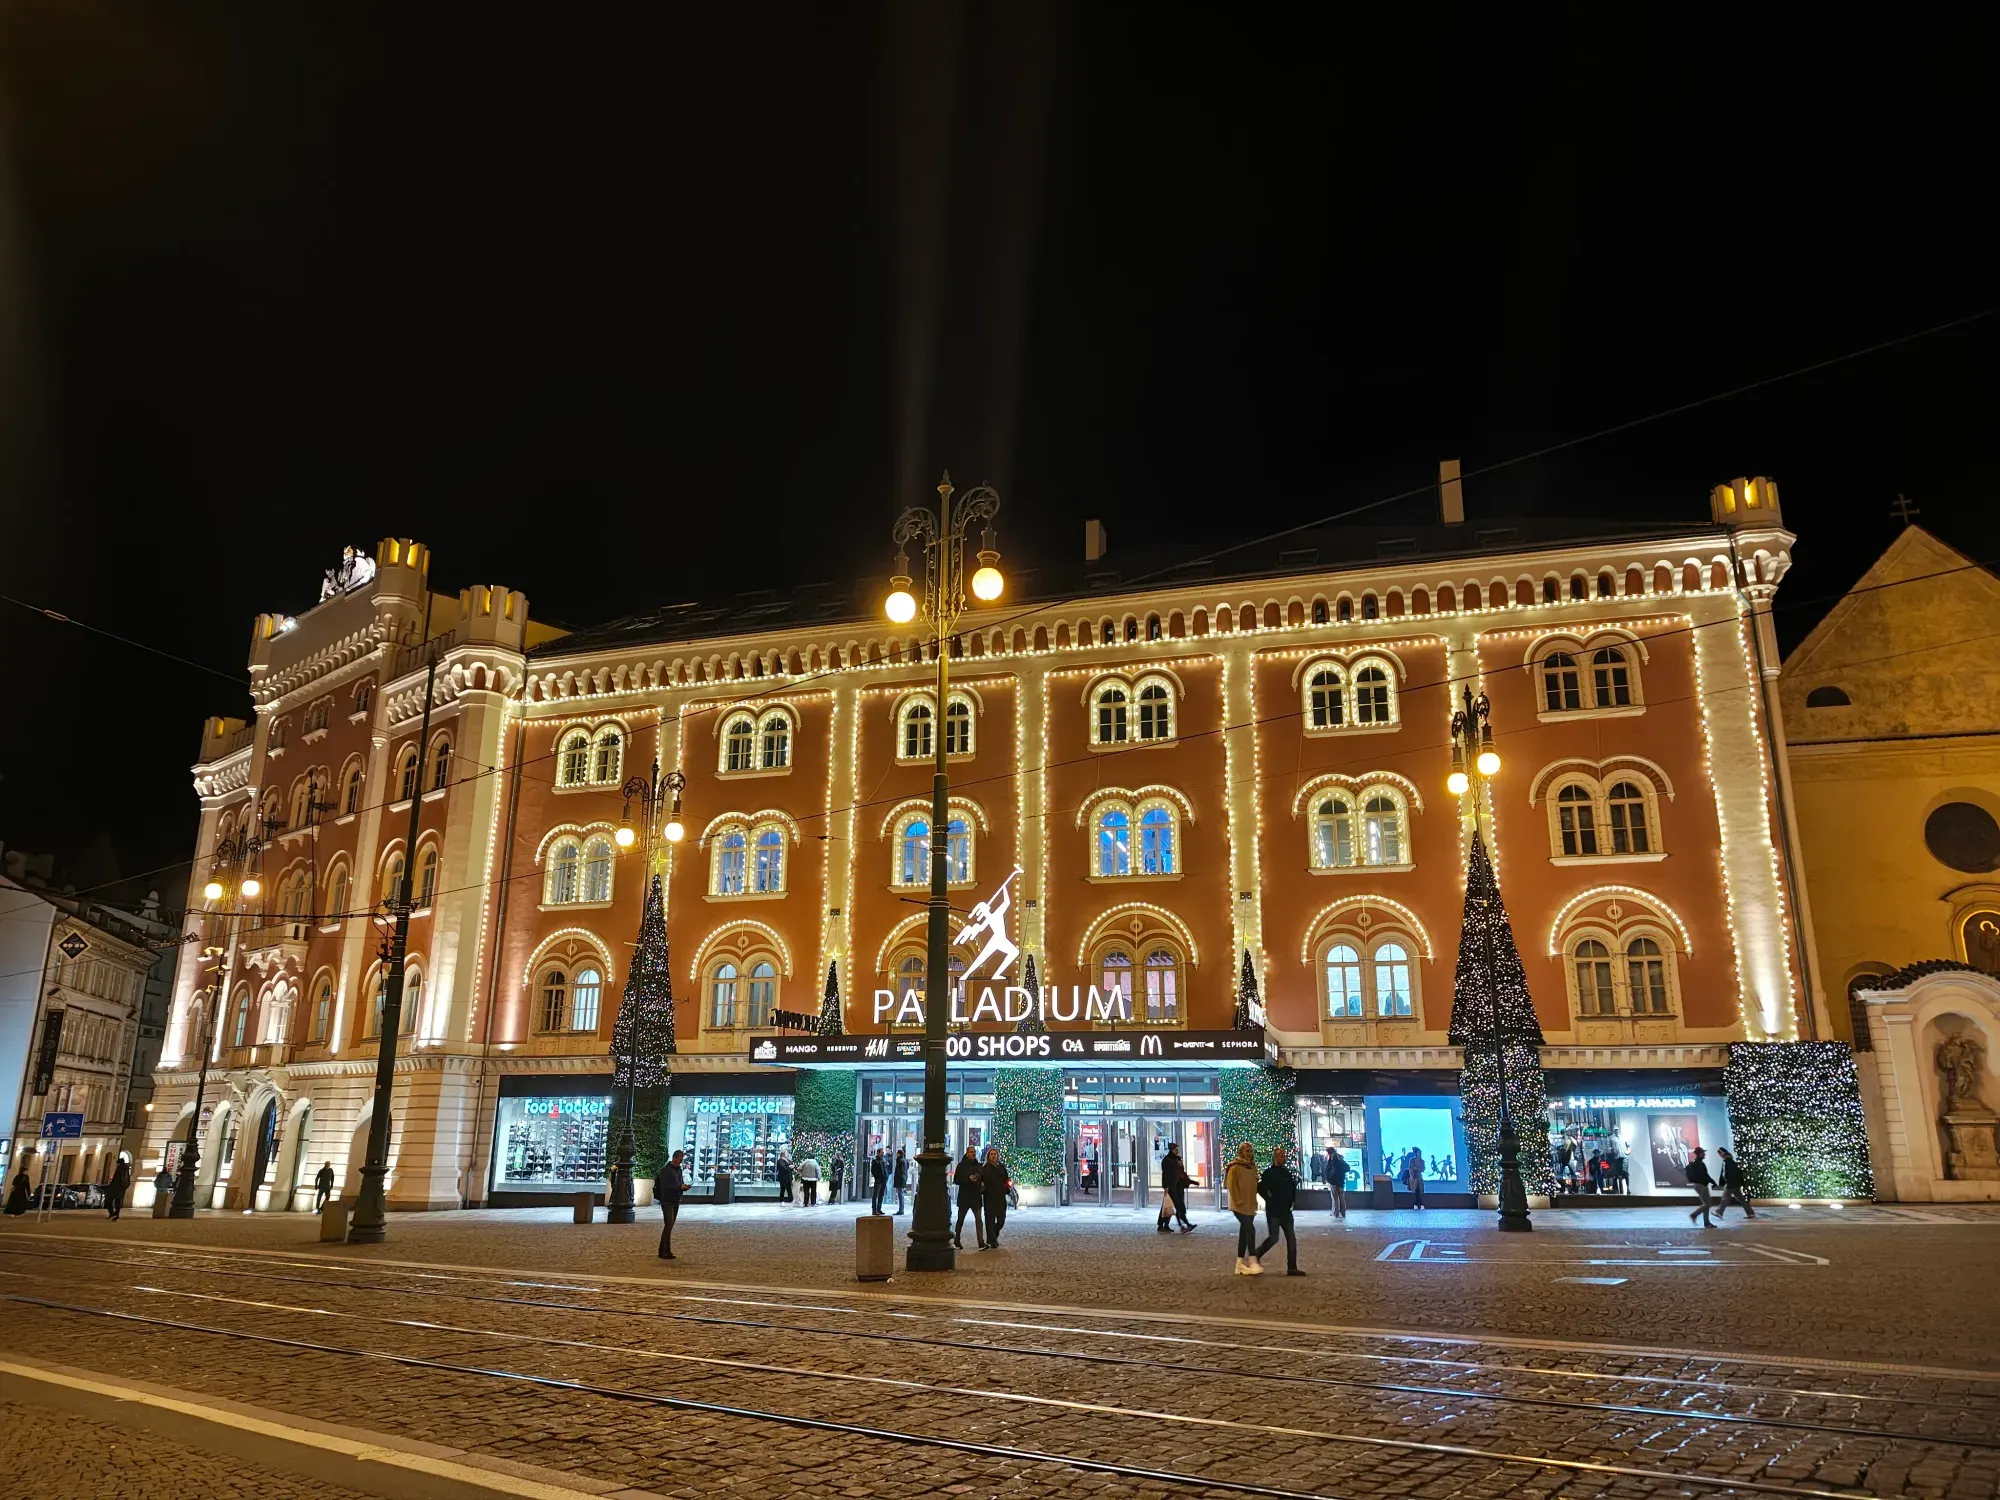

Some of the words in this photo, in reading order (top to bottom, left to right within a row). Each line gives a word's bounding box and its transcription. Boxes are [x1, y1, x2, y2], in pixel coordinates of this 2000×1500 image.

[873, 985, 1126, 1024] PALADIUM
[785, 1045, 818, 1054] MANGO
[864, 1038, 889, 1057] H&M
[946, 1037, 971, 1057] 00
[977, 1035, 1051, 1056] SHOPS
[1062, 1038, 1084, 1052] C&A
[524, 1098, 553, 1114] Foot
[558, 1098, 605, 1114] Locker
[693, 1097, 726, 1114] Foot
[730, 1097, 782, 1114] Locker
[1590, 1098, 1636, 1108] UNDER
[1637, 1097, 1696, 1108] ARMOUR
[167, 1144, 176, 1173] CHANGE
